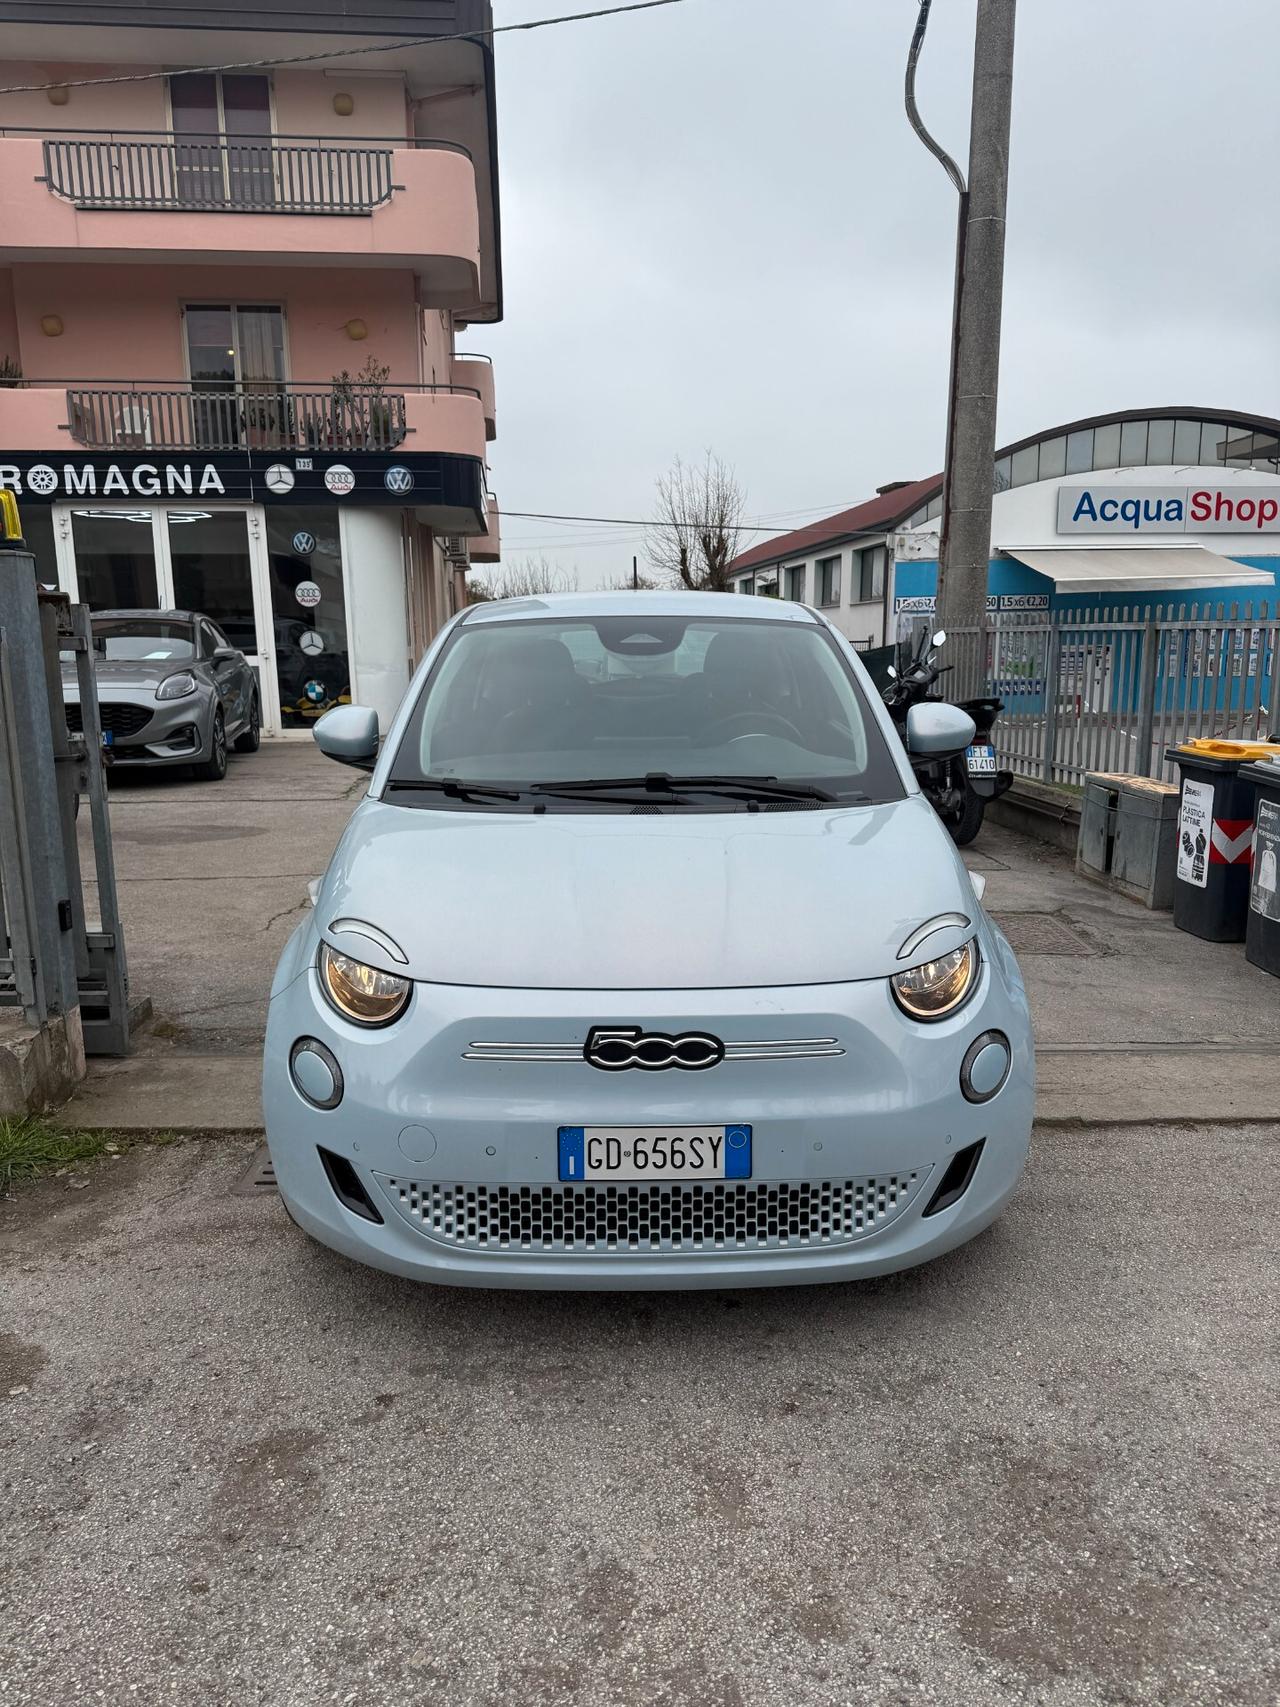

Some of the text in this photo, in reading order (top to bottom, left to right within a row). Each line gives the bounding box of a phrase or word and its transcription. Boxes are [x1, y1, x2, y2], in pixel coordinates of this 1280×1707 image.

[0, 464, 225, 495] ROMAGNA
[1072, 491, 1279, 529] Acqua Shop
[586, 1028, 722, 1069] 500
